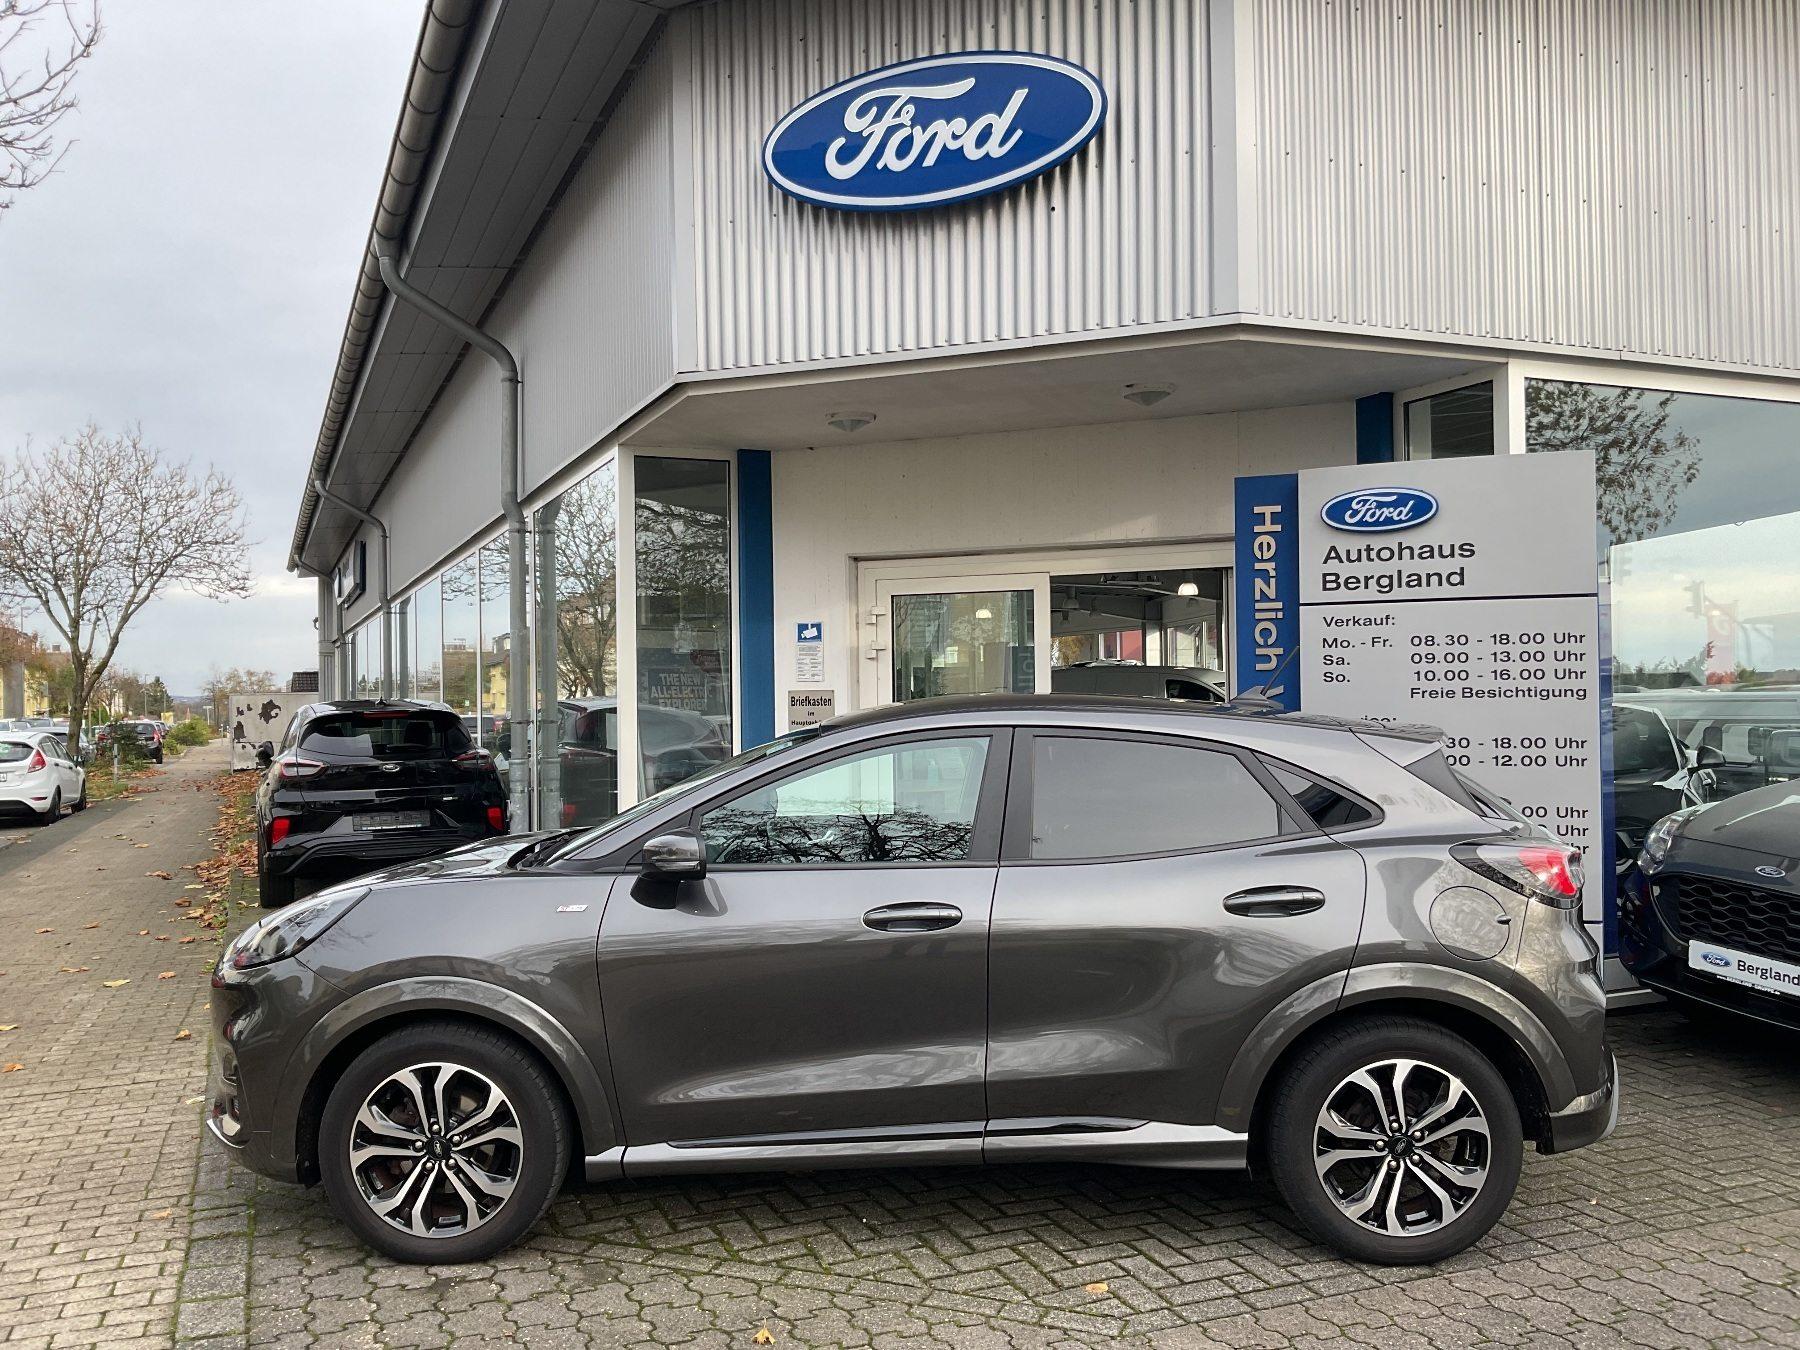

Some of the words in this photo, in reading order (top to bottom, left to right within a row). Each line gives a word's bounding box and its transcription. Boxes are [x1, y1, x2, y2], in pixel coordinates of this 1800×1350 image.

[825, 78, 1029, 180] Ford
[1344, 495, 1415, 524] Ford
[1322, 542, 1476, 564] Autohaus
[1253, 504, 1284, 671] Herzlich
[1321, 567, 1465, 594] Bergland
[1322, 615, 1396, 627] Verkauf:
[1322, 638, 1356, 648] Mo.
[1371, 636, 1393, 648] Fr.
[1410, 634, 1469, 646] 08.30
[1489, 632, 1545, 645] 18.00
[1553, 632, 1586, 644] Uhr
[1322, 654, 1351, 665] Sa.
[1410, 652, 1469, 664] 09.00
[1490, 650, 1545, 662] 13.00
[1553, 650, 1586, 662] Uhr
[1322, 671, 1351, 682] So.
[1413, 669, 1469, 681] 10.00
[1490, 668, 1545, 680] 16.00
[1554, 668, 1587, 680] Uhr
[790, 695, 832, 707] Briefkasten
[1410, 687, 1456, 699] Freie
[1461, 686, 1587, 701] Besichtigung
[1445, 737, 1470, 749] 30
[1491, 737, 1546, 749] 18.00
[1555, 737, 1587, 749] Uhr
[1491, 754, 1547, 767] 12.00
[1555, 755, 1588, 767] Uhr
[1556, 806, 1589, 818] Uhr
[1556, 824, 1589, 837] Uhr
[1736, 959, 1800, 986] Bergland
